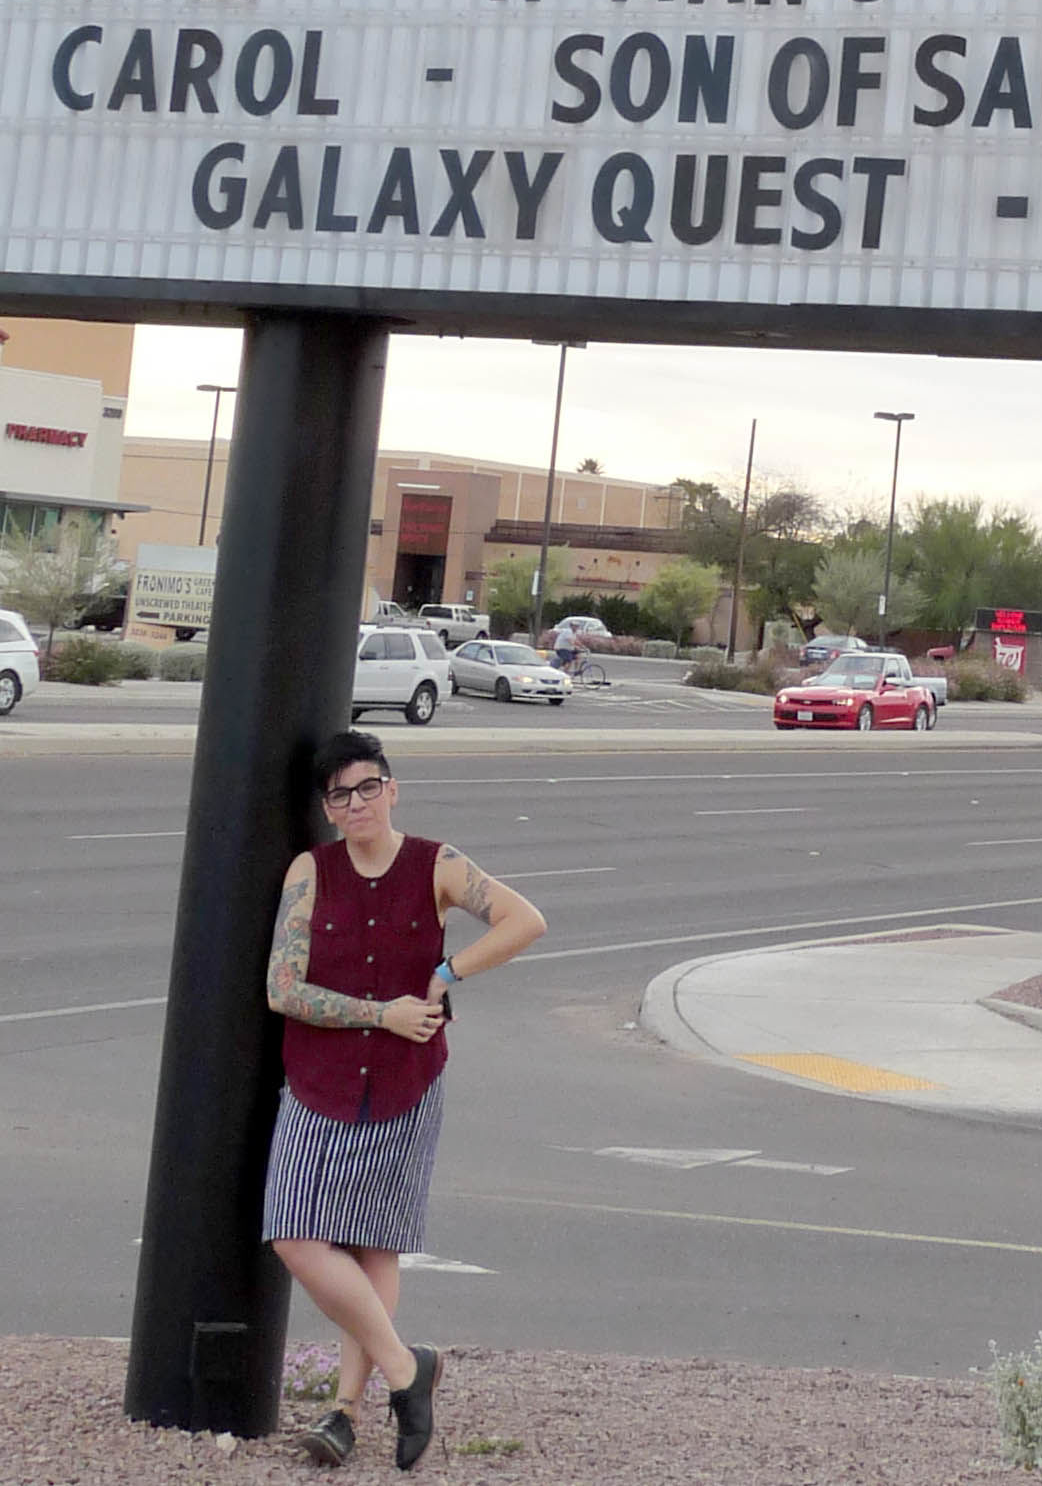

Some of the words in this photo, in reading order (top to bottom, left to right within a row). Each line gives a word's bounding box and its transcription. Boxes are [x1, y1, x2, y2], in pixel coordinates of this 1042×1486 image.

[51, 24, 340, 117] CAROL
[551, 31, 736, 125] SON
[767, 36, 886, 131] OF
[191, 141, 565, 241] GALAXY
[591, 151, 907, 252] QUEST
[5, 423, 88, 448] PHARMACY
[163, 612, 211, 625] PARKING
